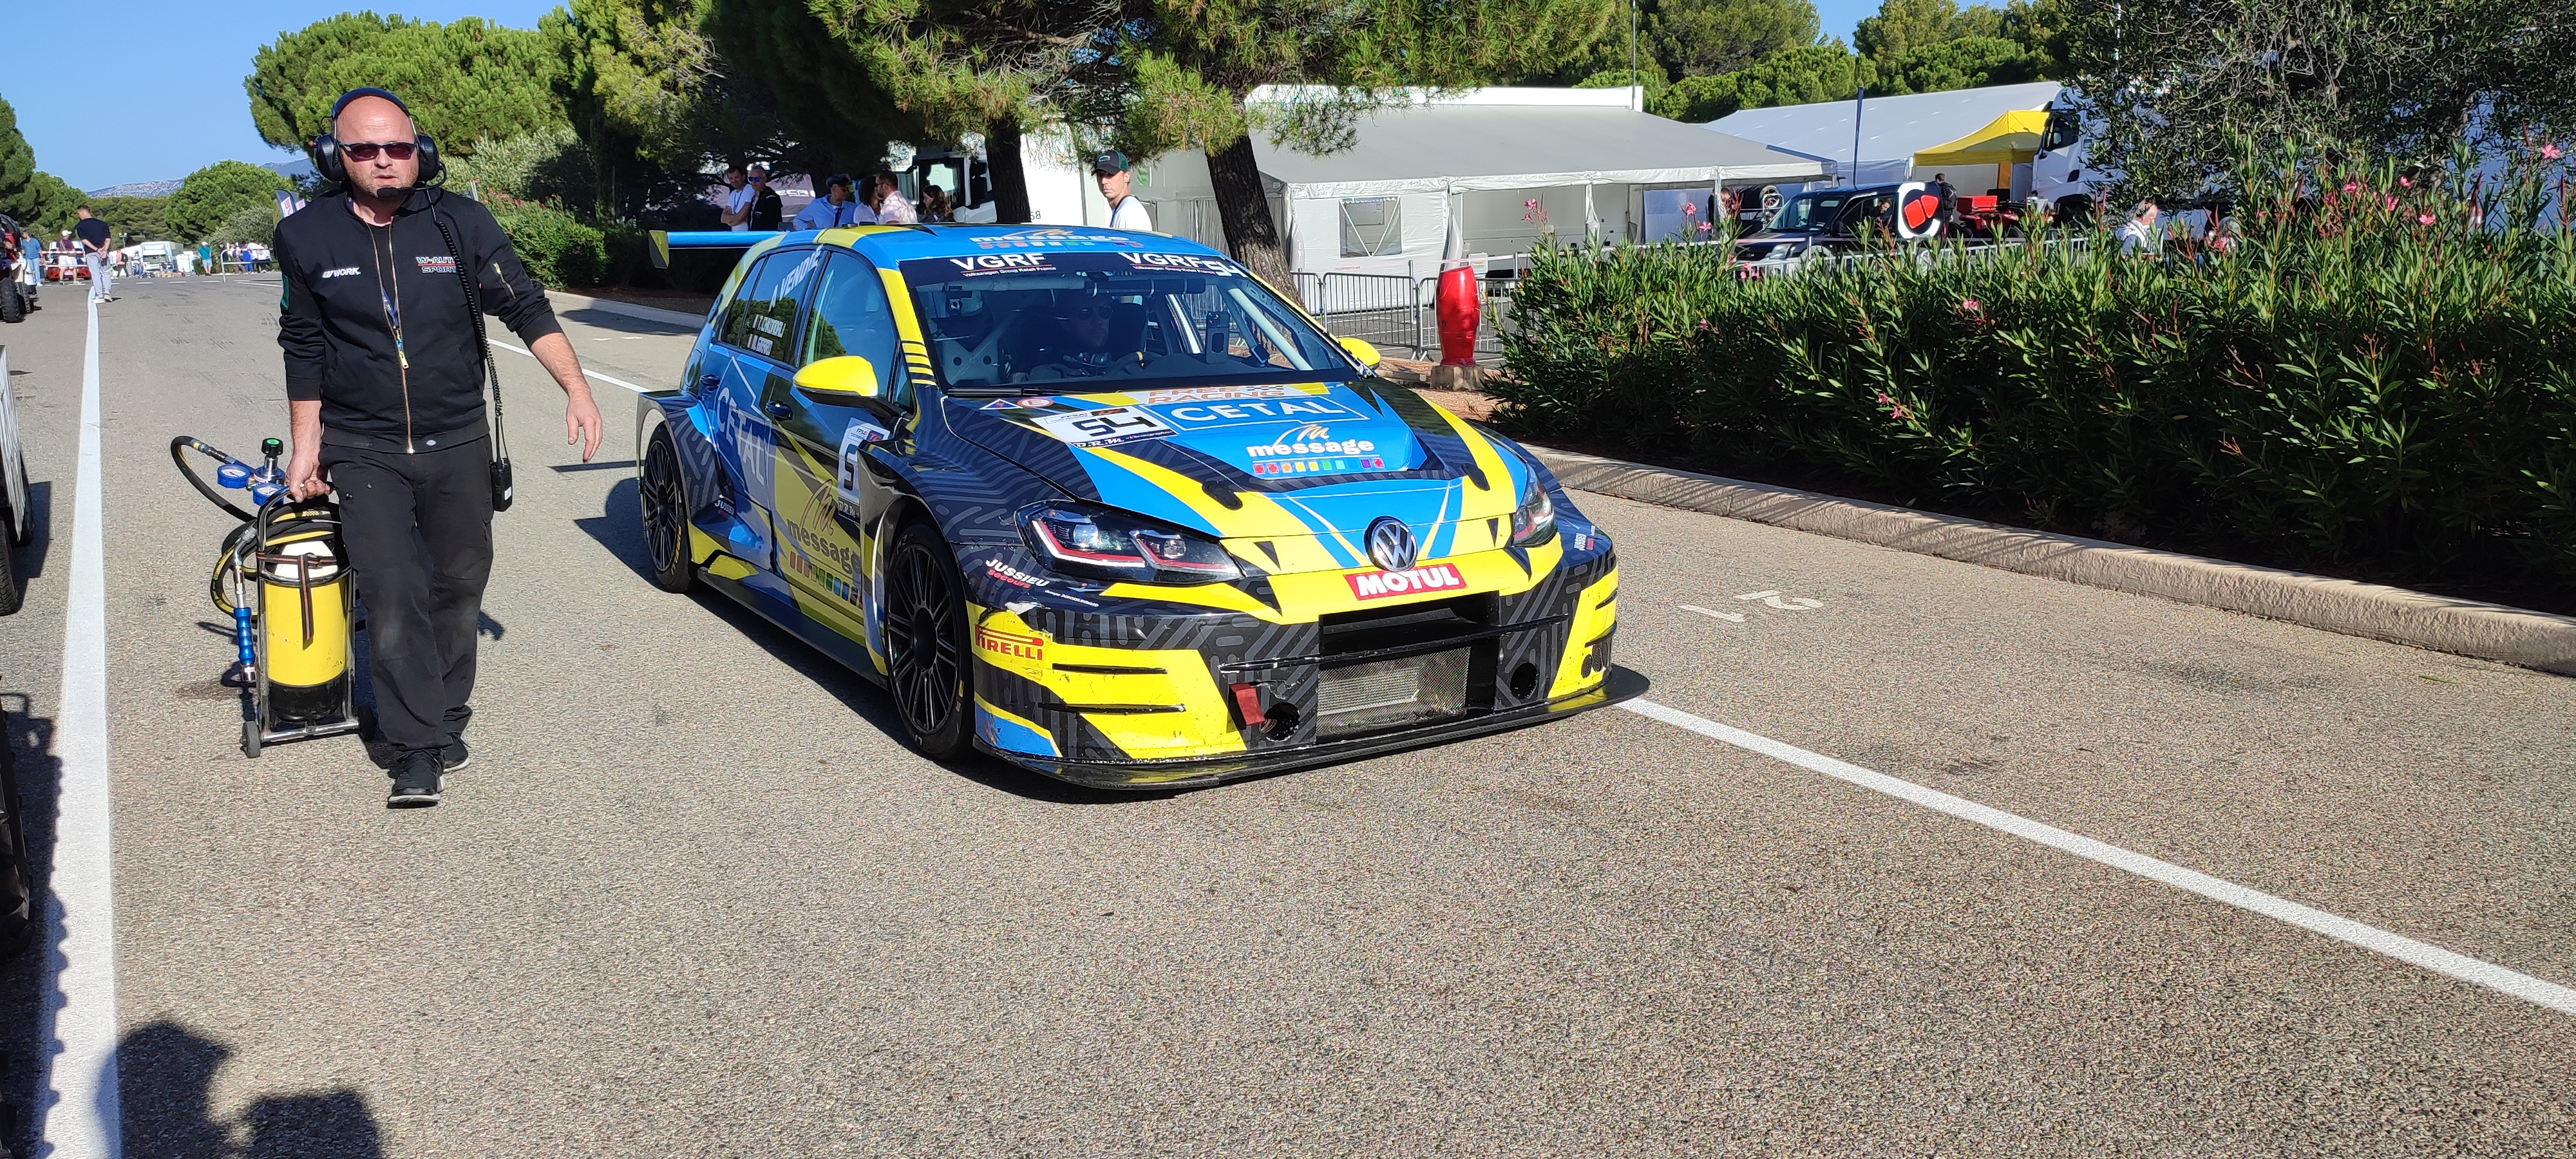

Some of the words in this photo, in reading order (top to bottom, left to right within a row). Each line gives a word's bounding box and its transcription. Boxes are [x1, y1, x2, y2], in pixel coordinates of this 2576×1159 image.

[950, 253, 1046, 270] VGRF
[1118, 252, 1205, 267] VGRF
[1201, 260, 1249, 278] 54
[1148, 391, 1285, 404] RACING
[1150, 386, 1240, 397] FREE
[1171, 402, 1346, 421] CETAL
[717, 387, 765, 486] CETAL
[1072, 416, 1159, 437] 54
[1246, 439, 1375, 457] message
[844, 443, 859, 491] 5
[786, 519, 862, 575] message
[985, 559, 1050, 587] JUSSIEU
[987, 569, 1032, 589] secours
[1356, 566, 1460, 596] MOTUL
[975, 623, 1043, 661] PIRELLI
